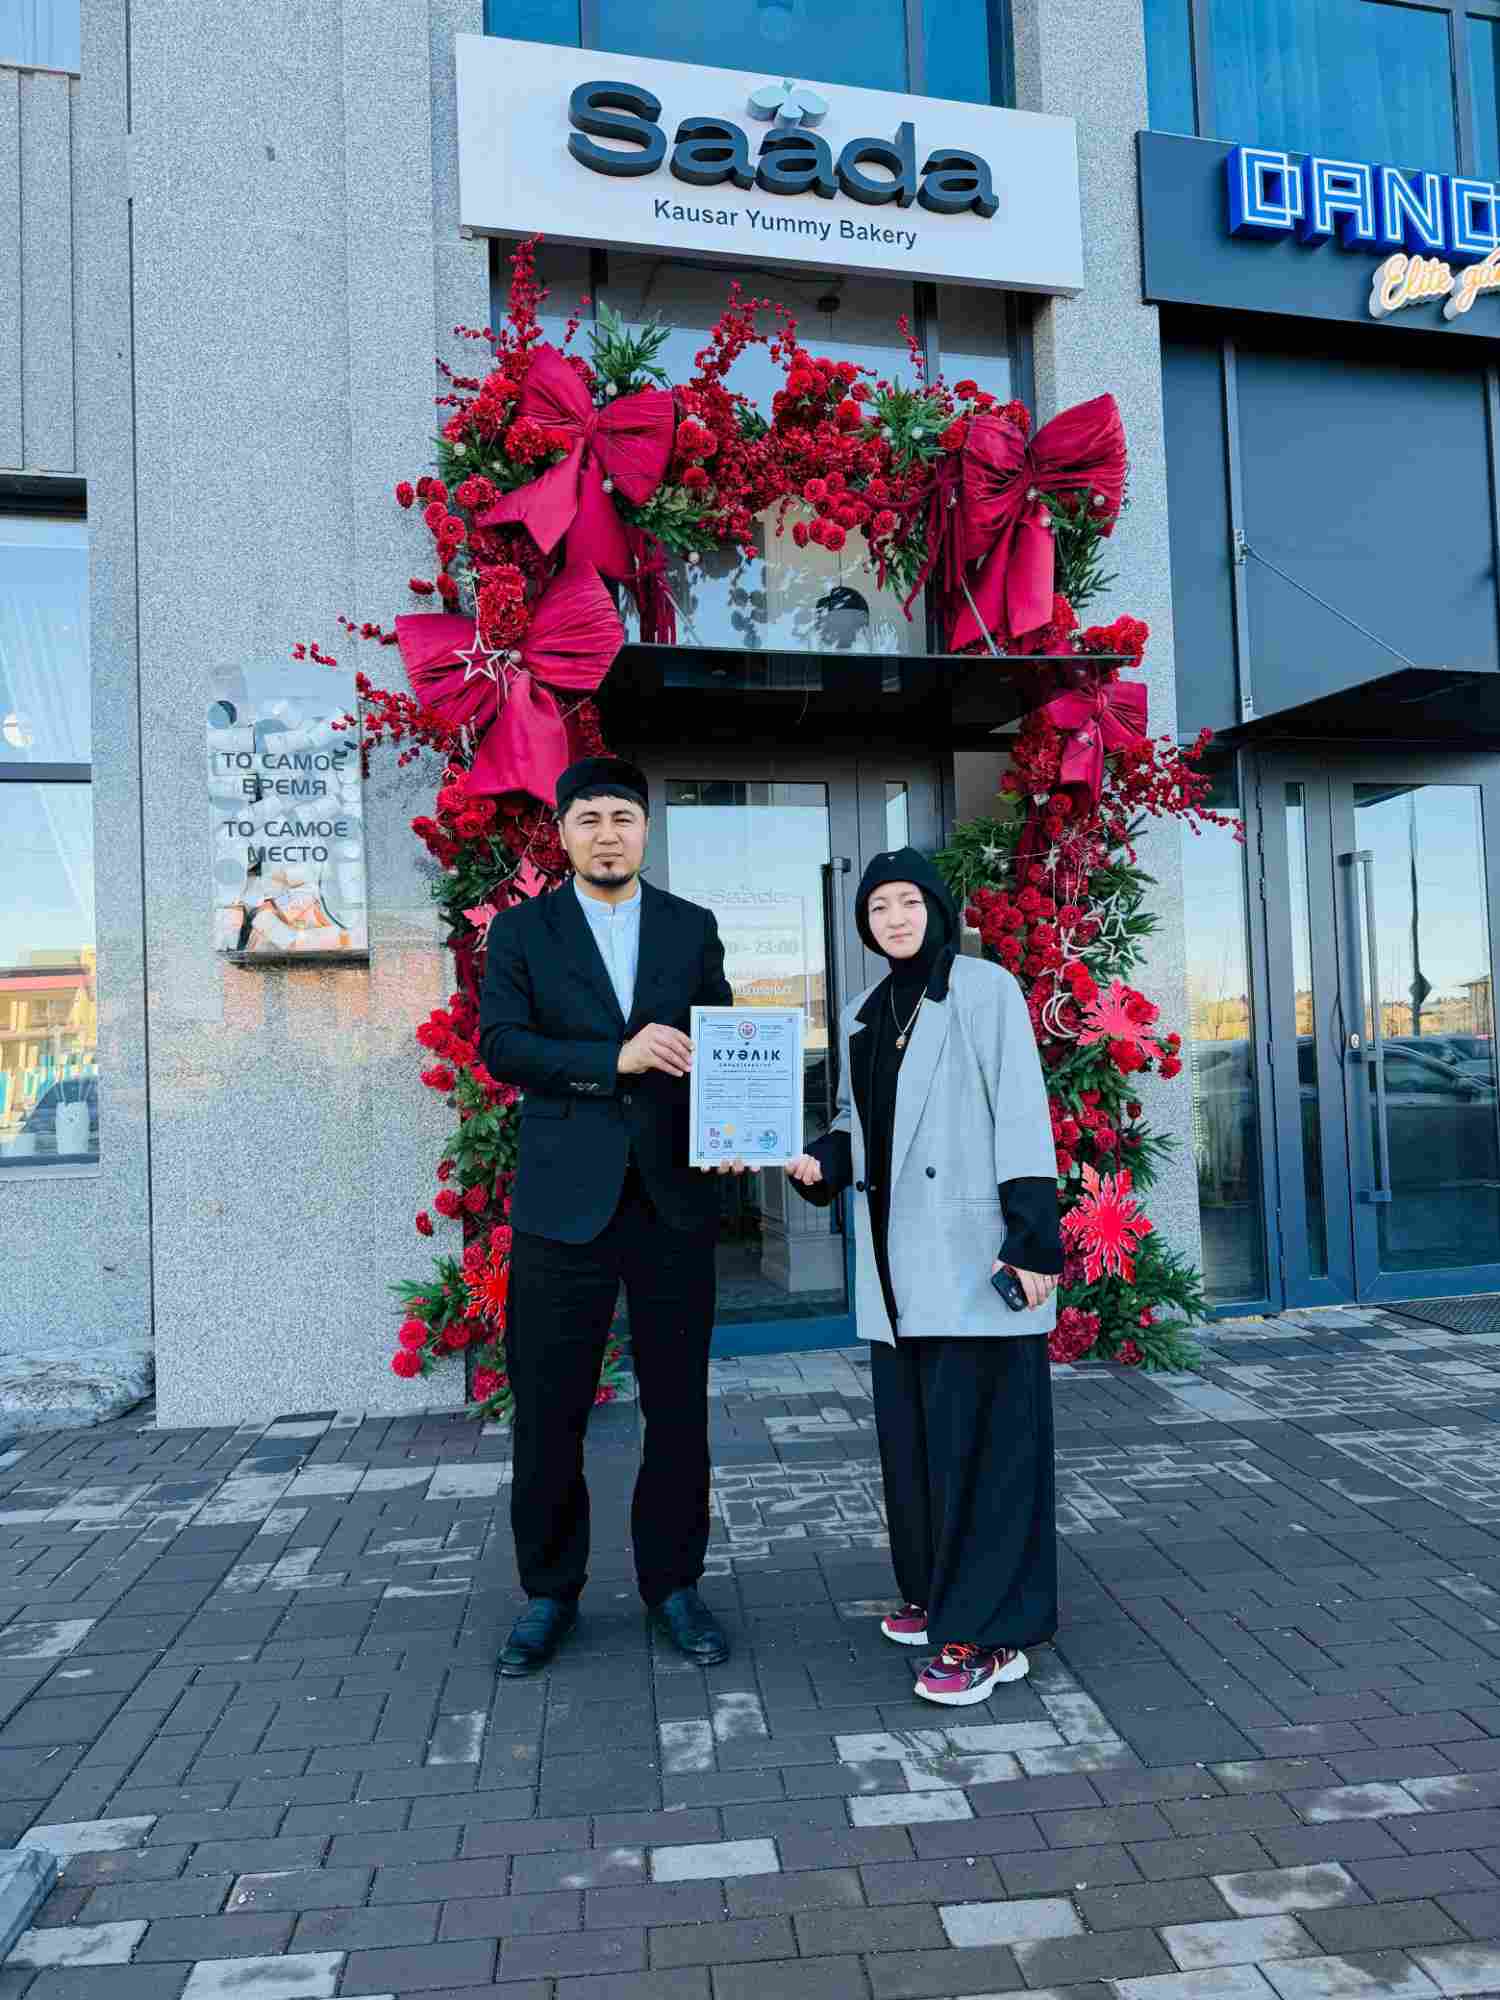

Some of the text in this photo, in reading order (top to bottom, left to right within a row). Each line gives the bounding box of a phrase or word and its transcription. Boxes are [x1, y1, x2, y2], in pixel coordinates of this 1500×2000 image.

[567, 80, 999, 218] Saada
[654, 199, 917, 250] Kausar Yummy Bakery
[1371, 253, 1455, 318] Elite
[221, 752, 346, 771] ТО САМОЕ
[242, 778, 328, 796] ВРЕМЯ
[223, 820, 348, 838] ТО САМОЕ
[247, 845, 329, 863] МЕСТО
[713, 1049, 780, 1061] КУӘЛІК
